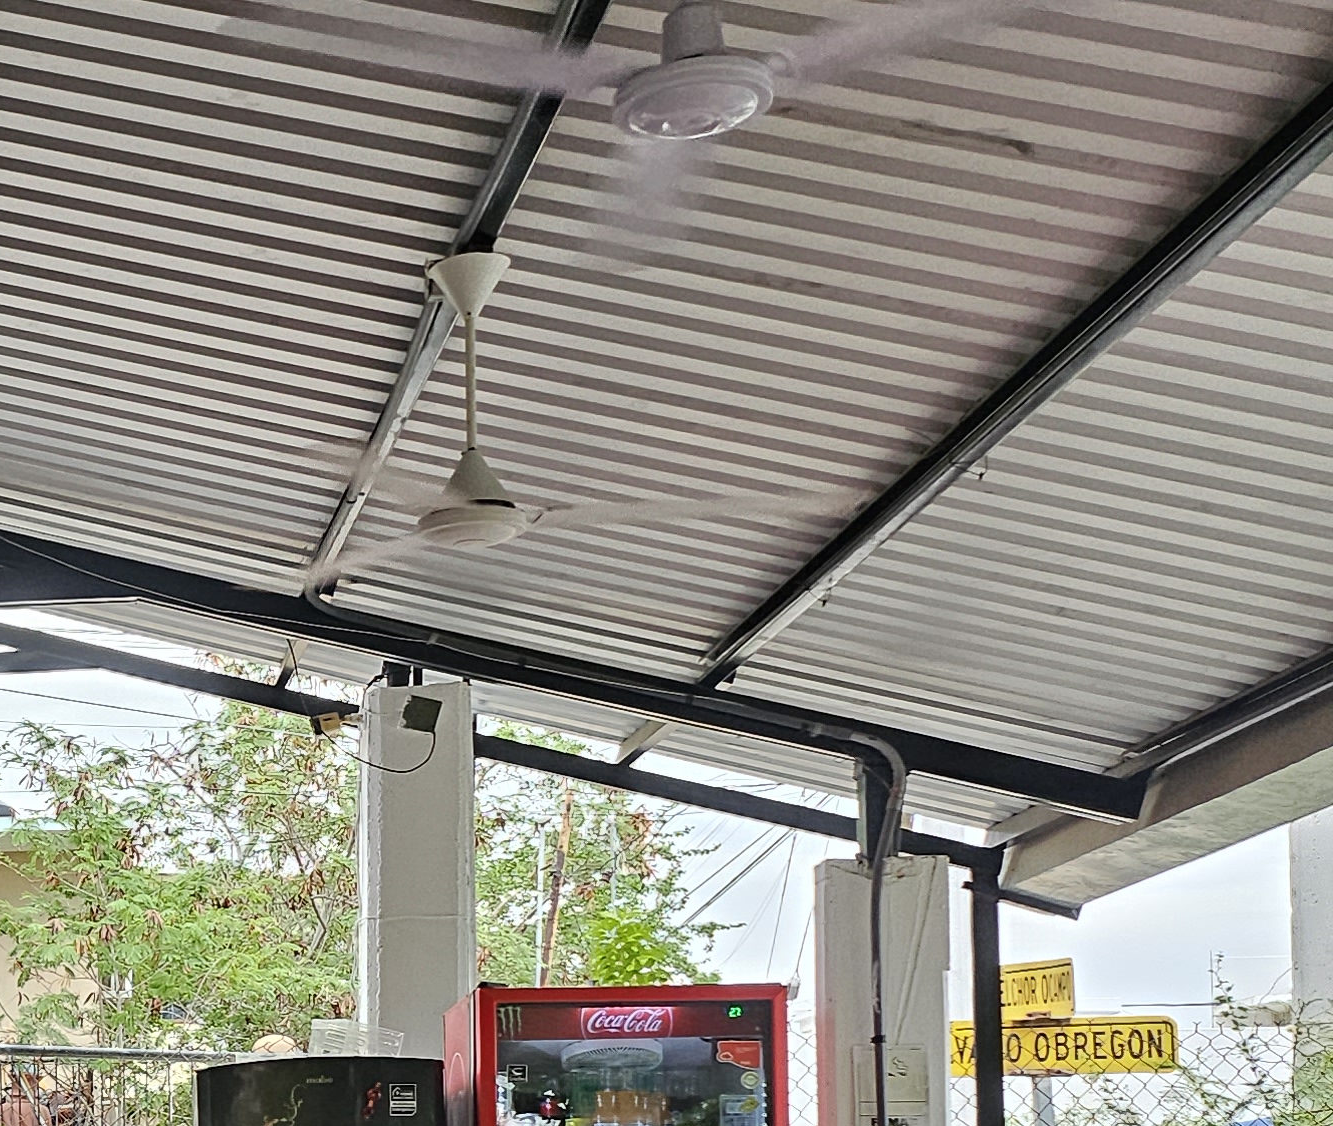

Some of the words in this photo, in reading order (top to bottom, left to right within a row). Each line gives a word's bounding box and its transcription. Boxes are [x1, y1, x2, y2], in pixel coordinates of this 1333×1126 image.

[1000, 976, 1038, 1007] ELCHOR
[587, 1008, 665, 1034] Coca-Cola
[1035, 1028, 1164, 1062] OBREGON
